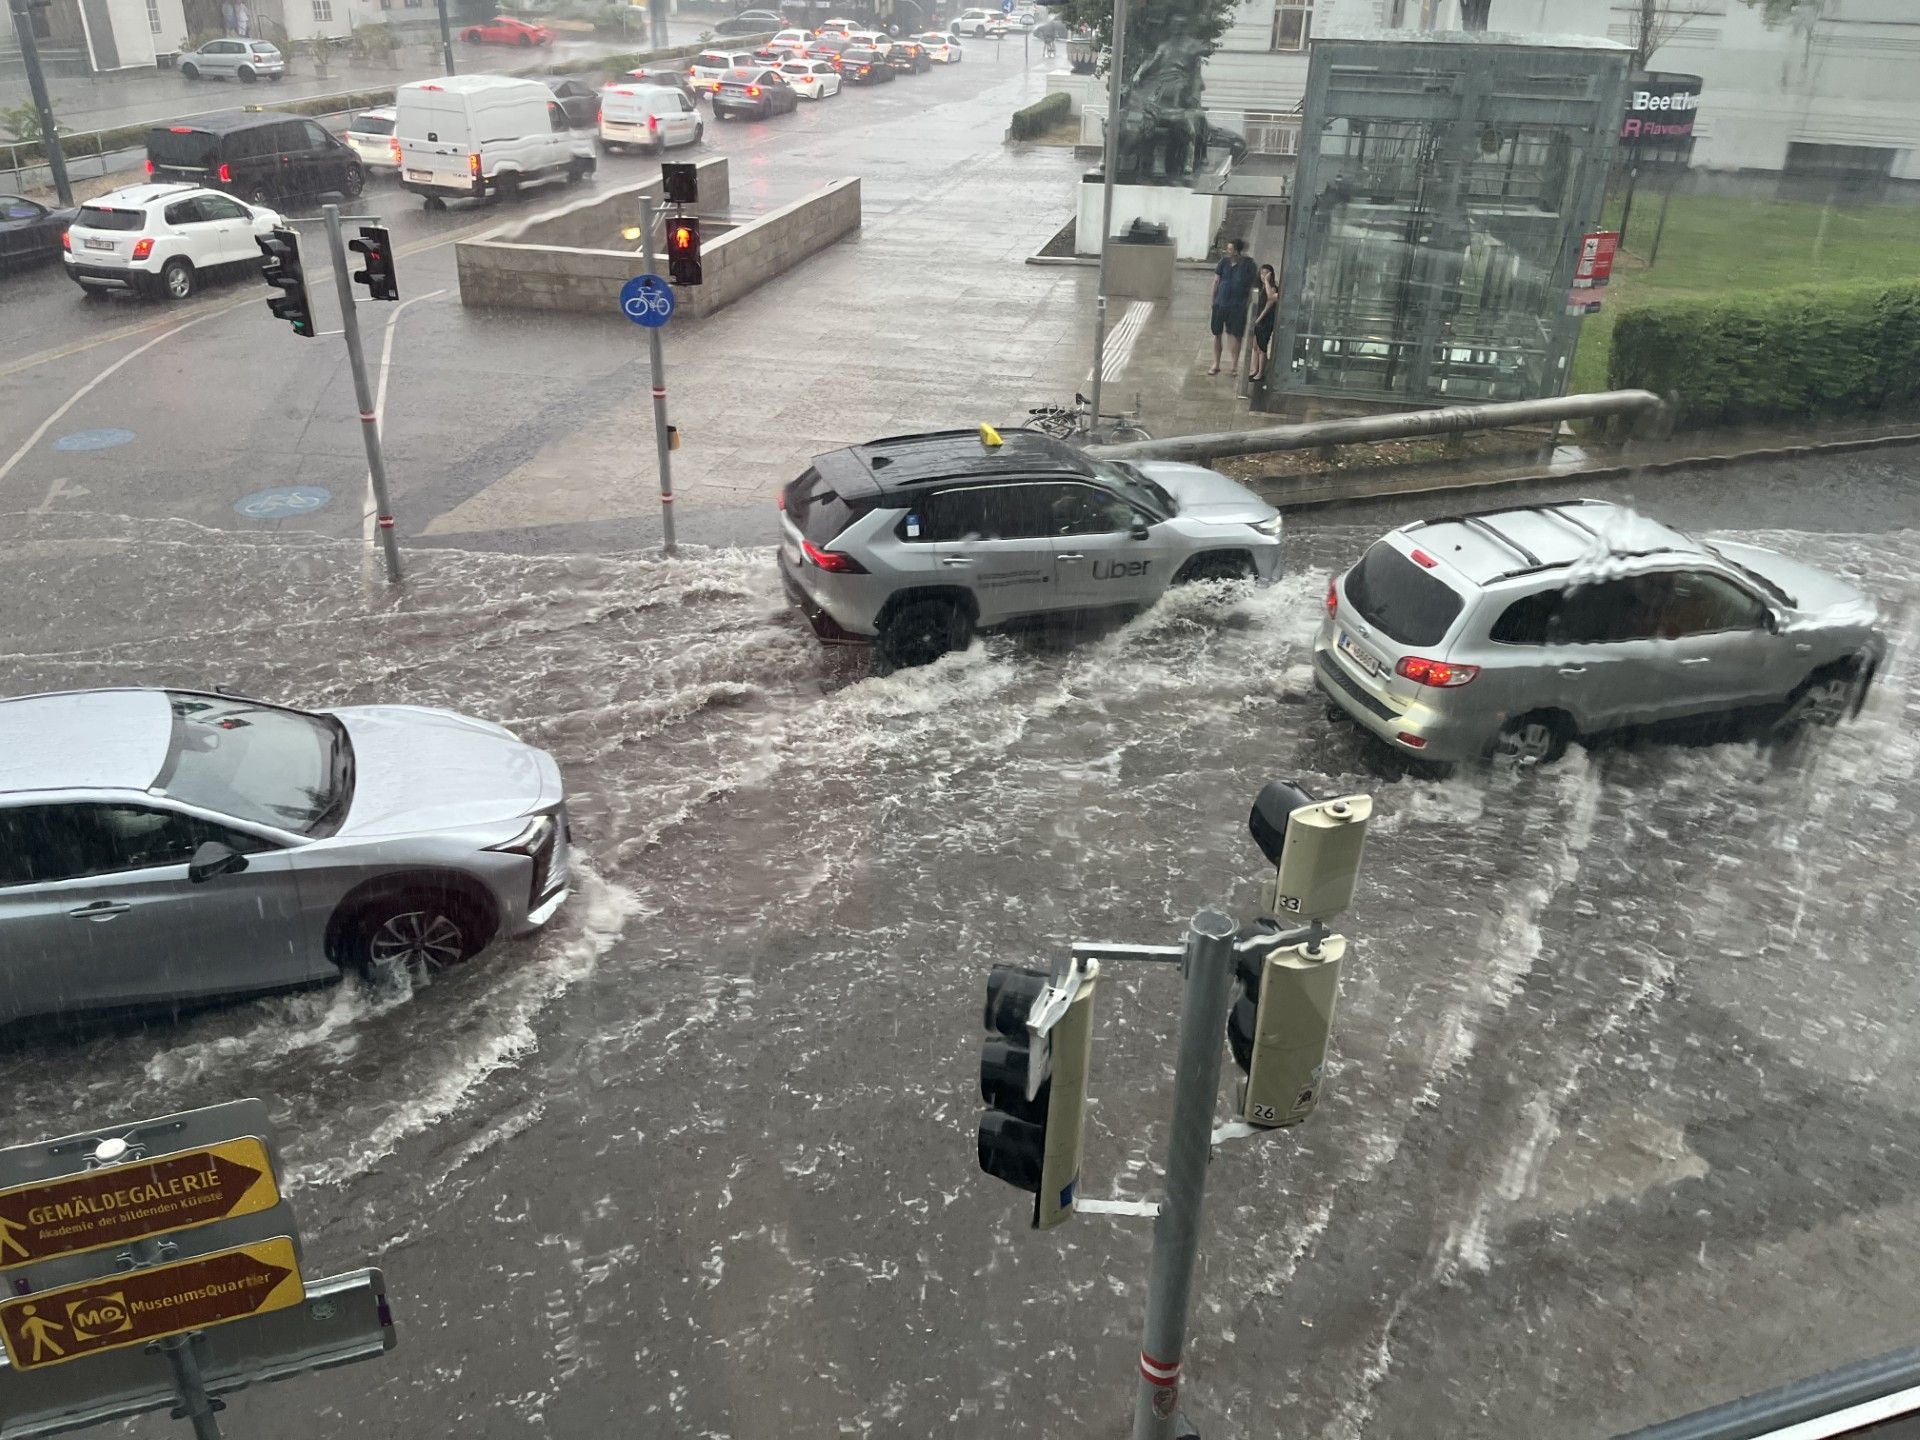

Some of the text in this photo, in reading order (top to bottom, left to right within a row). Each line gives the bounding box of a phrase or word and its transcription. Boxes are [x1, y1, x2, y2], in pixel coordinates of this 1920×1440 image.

[1092, 560, 1151, 580] Uber
[1280, 894, 1299, 910] 33
[1254, 1105, 1274, 1119] 26
[28, 1169, 221, 1225] GEMÄLDEGALERIE
[39, 1221, 94, 1240] Akademie
[98, 1215, 116, 1228] der
[120, 1202, 178, 1223] bildenden
[77, 1273, 271, 1328] MQ MuseumsQuartier
